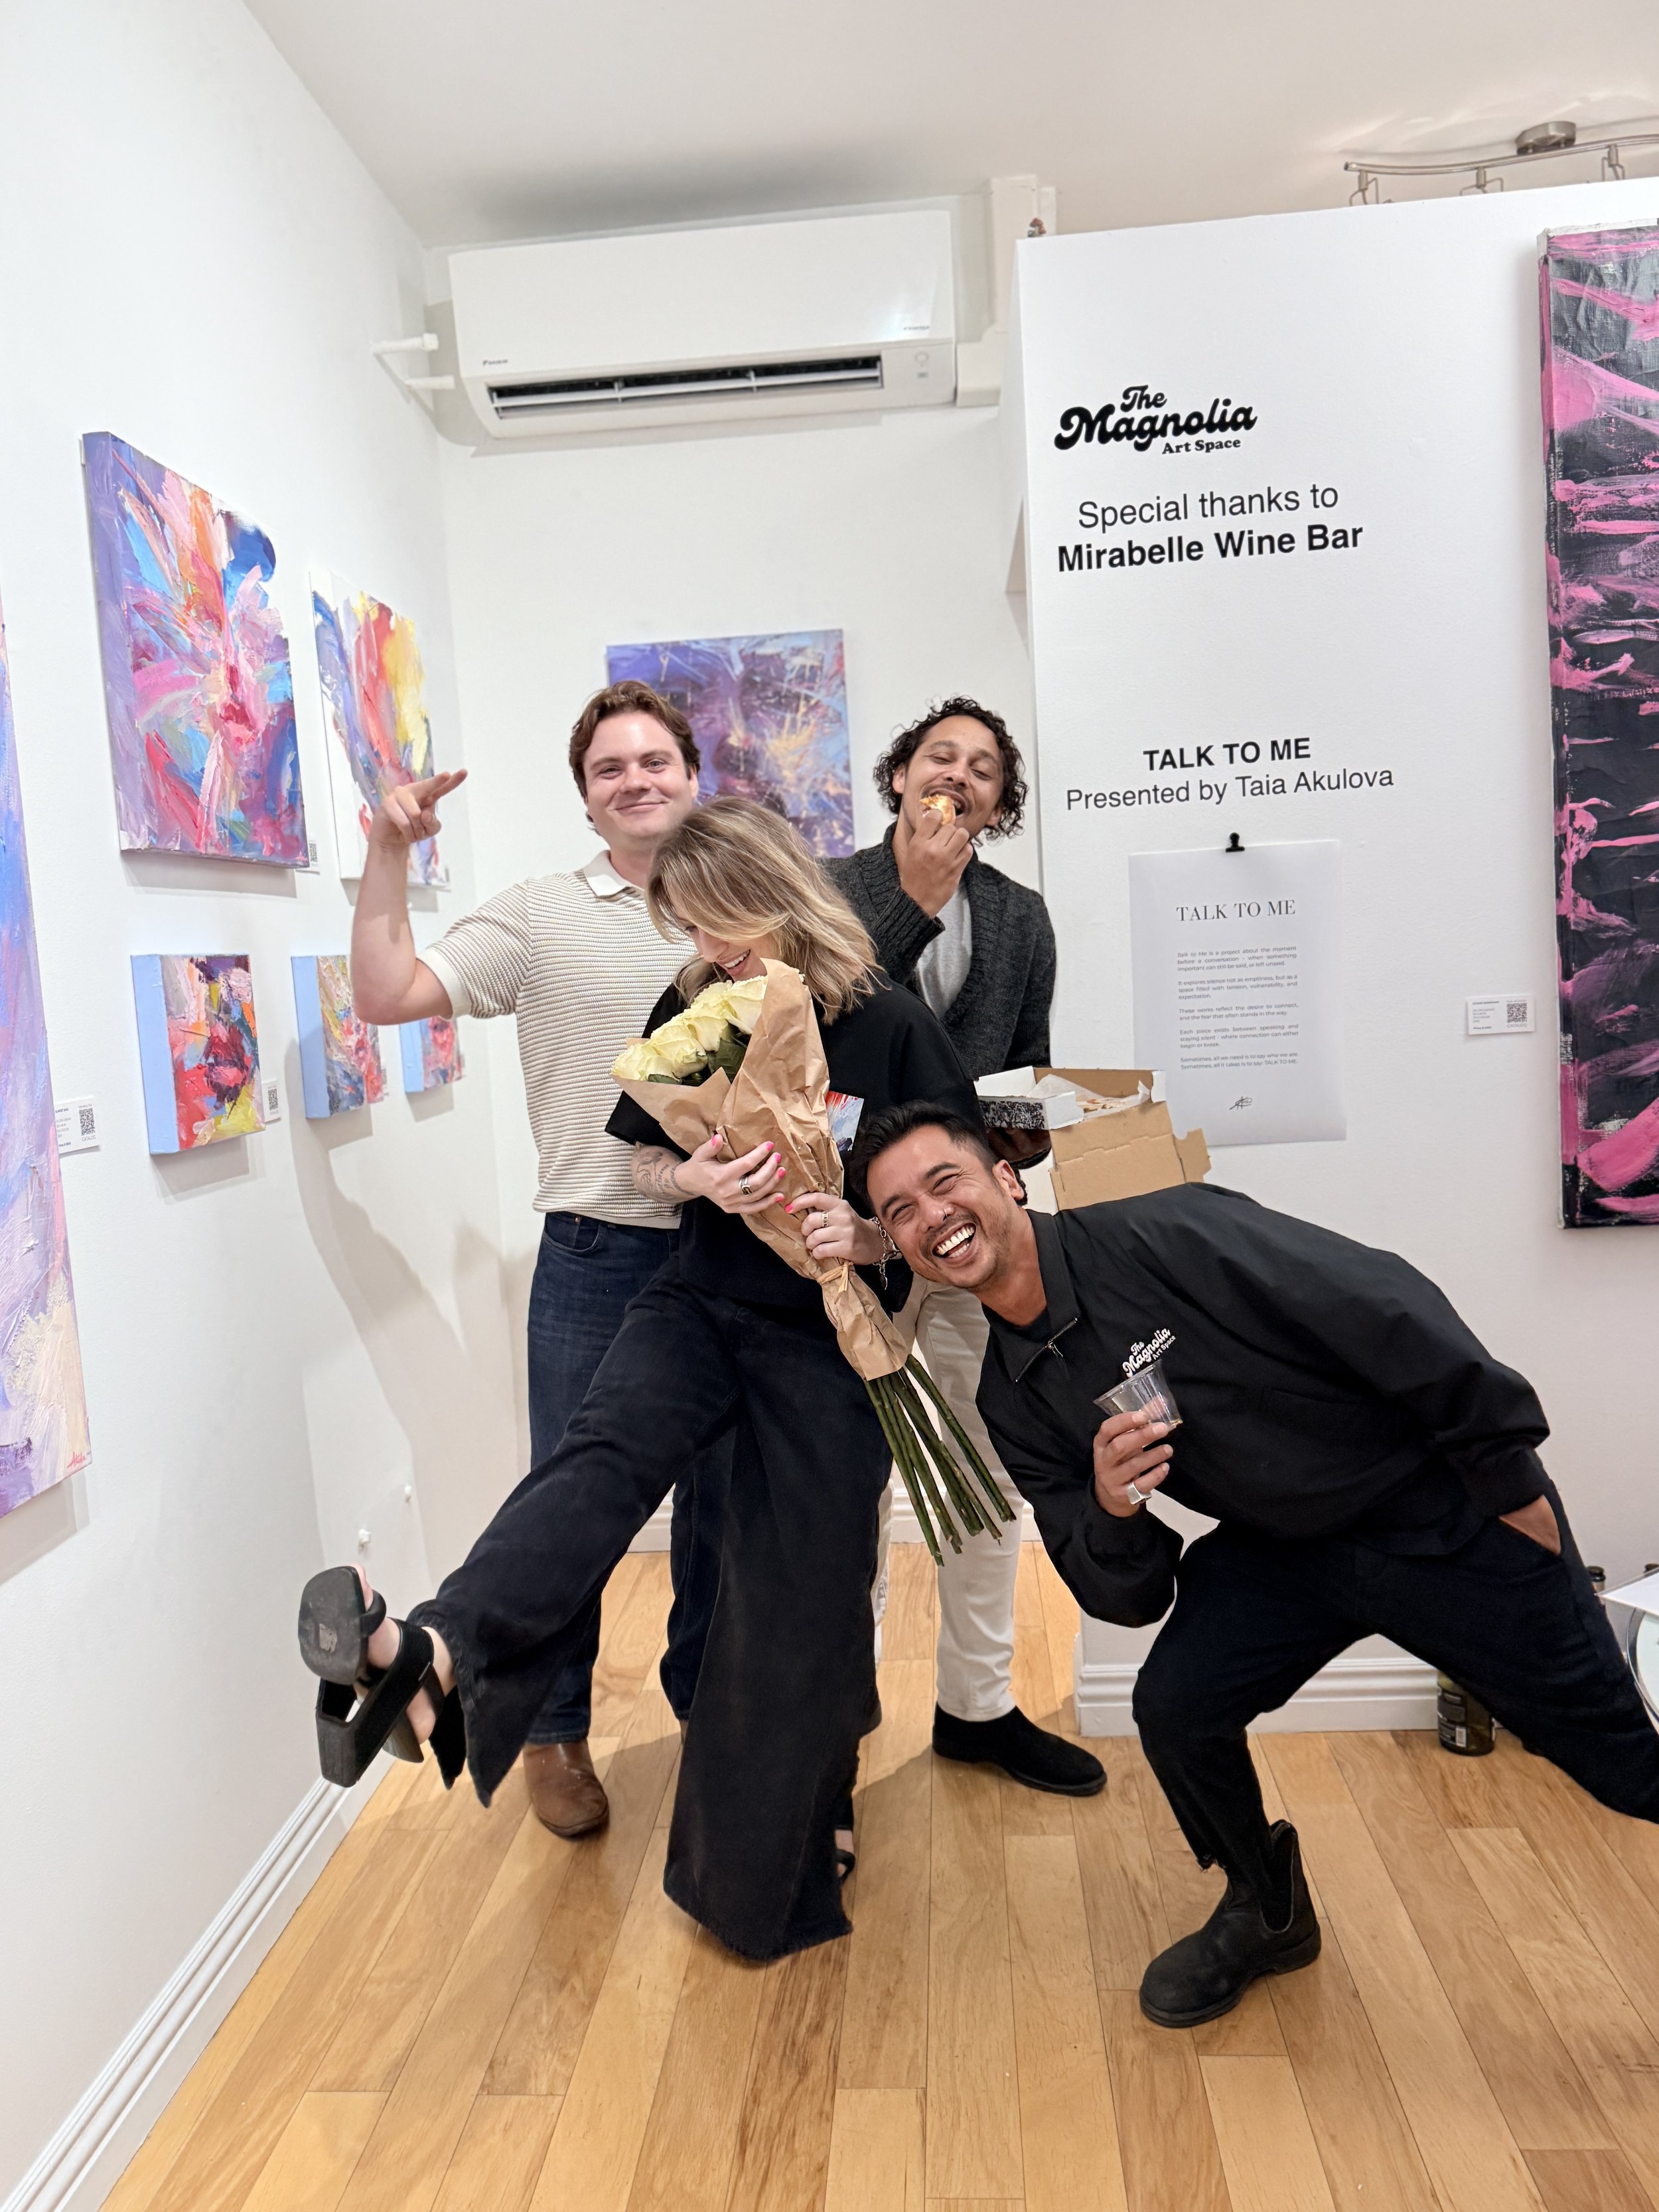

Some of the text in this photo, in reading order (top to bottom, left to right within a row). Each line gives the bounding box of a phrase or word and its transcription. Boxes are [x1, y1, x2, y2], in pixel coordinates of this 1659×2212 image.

[1120, 385, 1167, 413] The
[1054, 398, 1258, 452] Magnolia
[1161, 437, 1241, 454] Art Space
[1079, 484, 1338, 533] Special thanks to
[1058, 524, 1362, 572] Mirabelle Wine Bar
[1143, 738, 1311, 770] TALK TO ME
[1067, 768, 1394, 810] Presented by Taia Akulova
[1176, 900, 1295, 922] TALK TO ME
[1122, 1328, 1171, 1378] Magnolia
[1131, 1342, 1145, 1356] The
